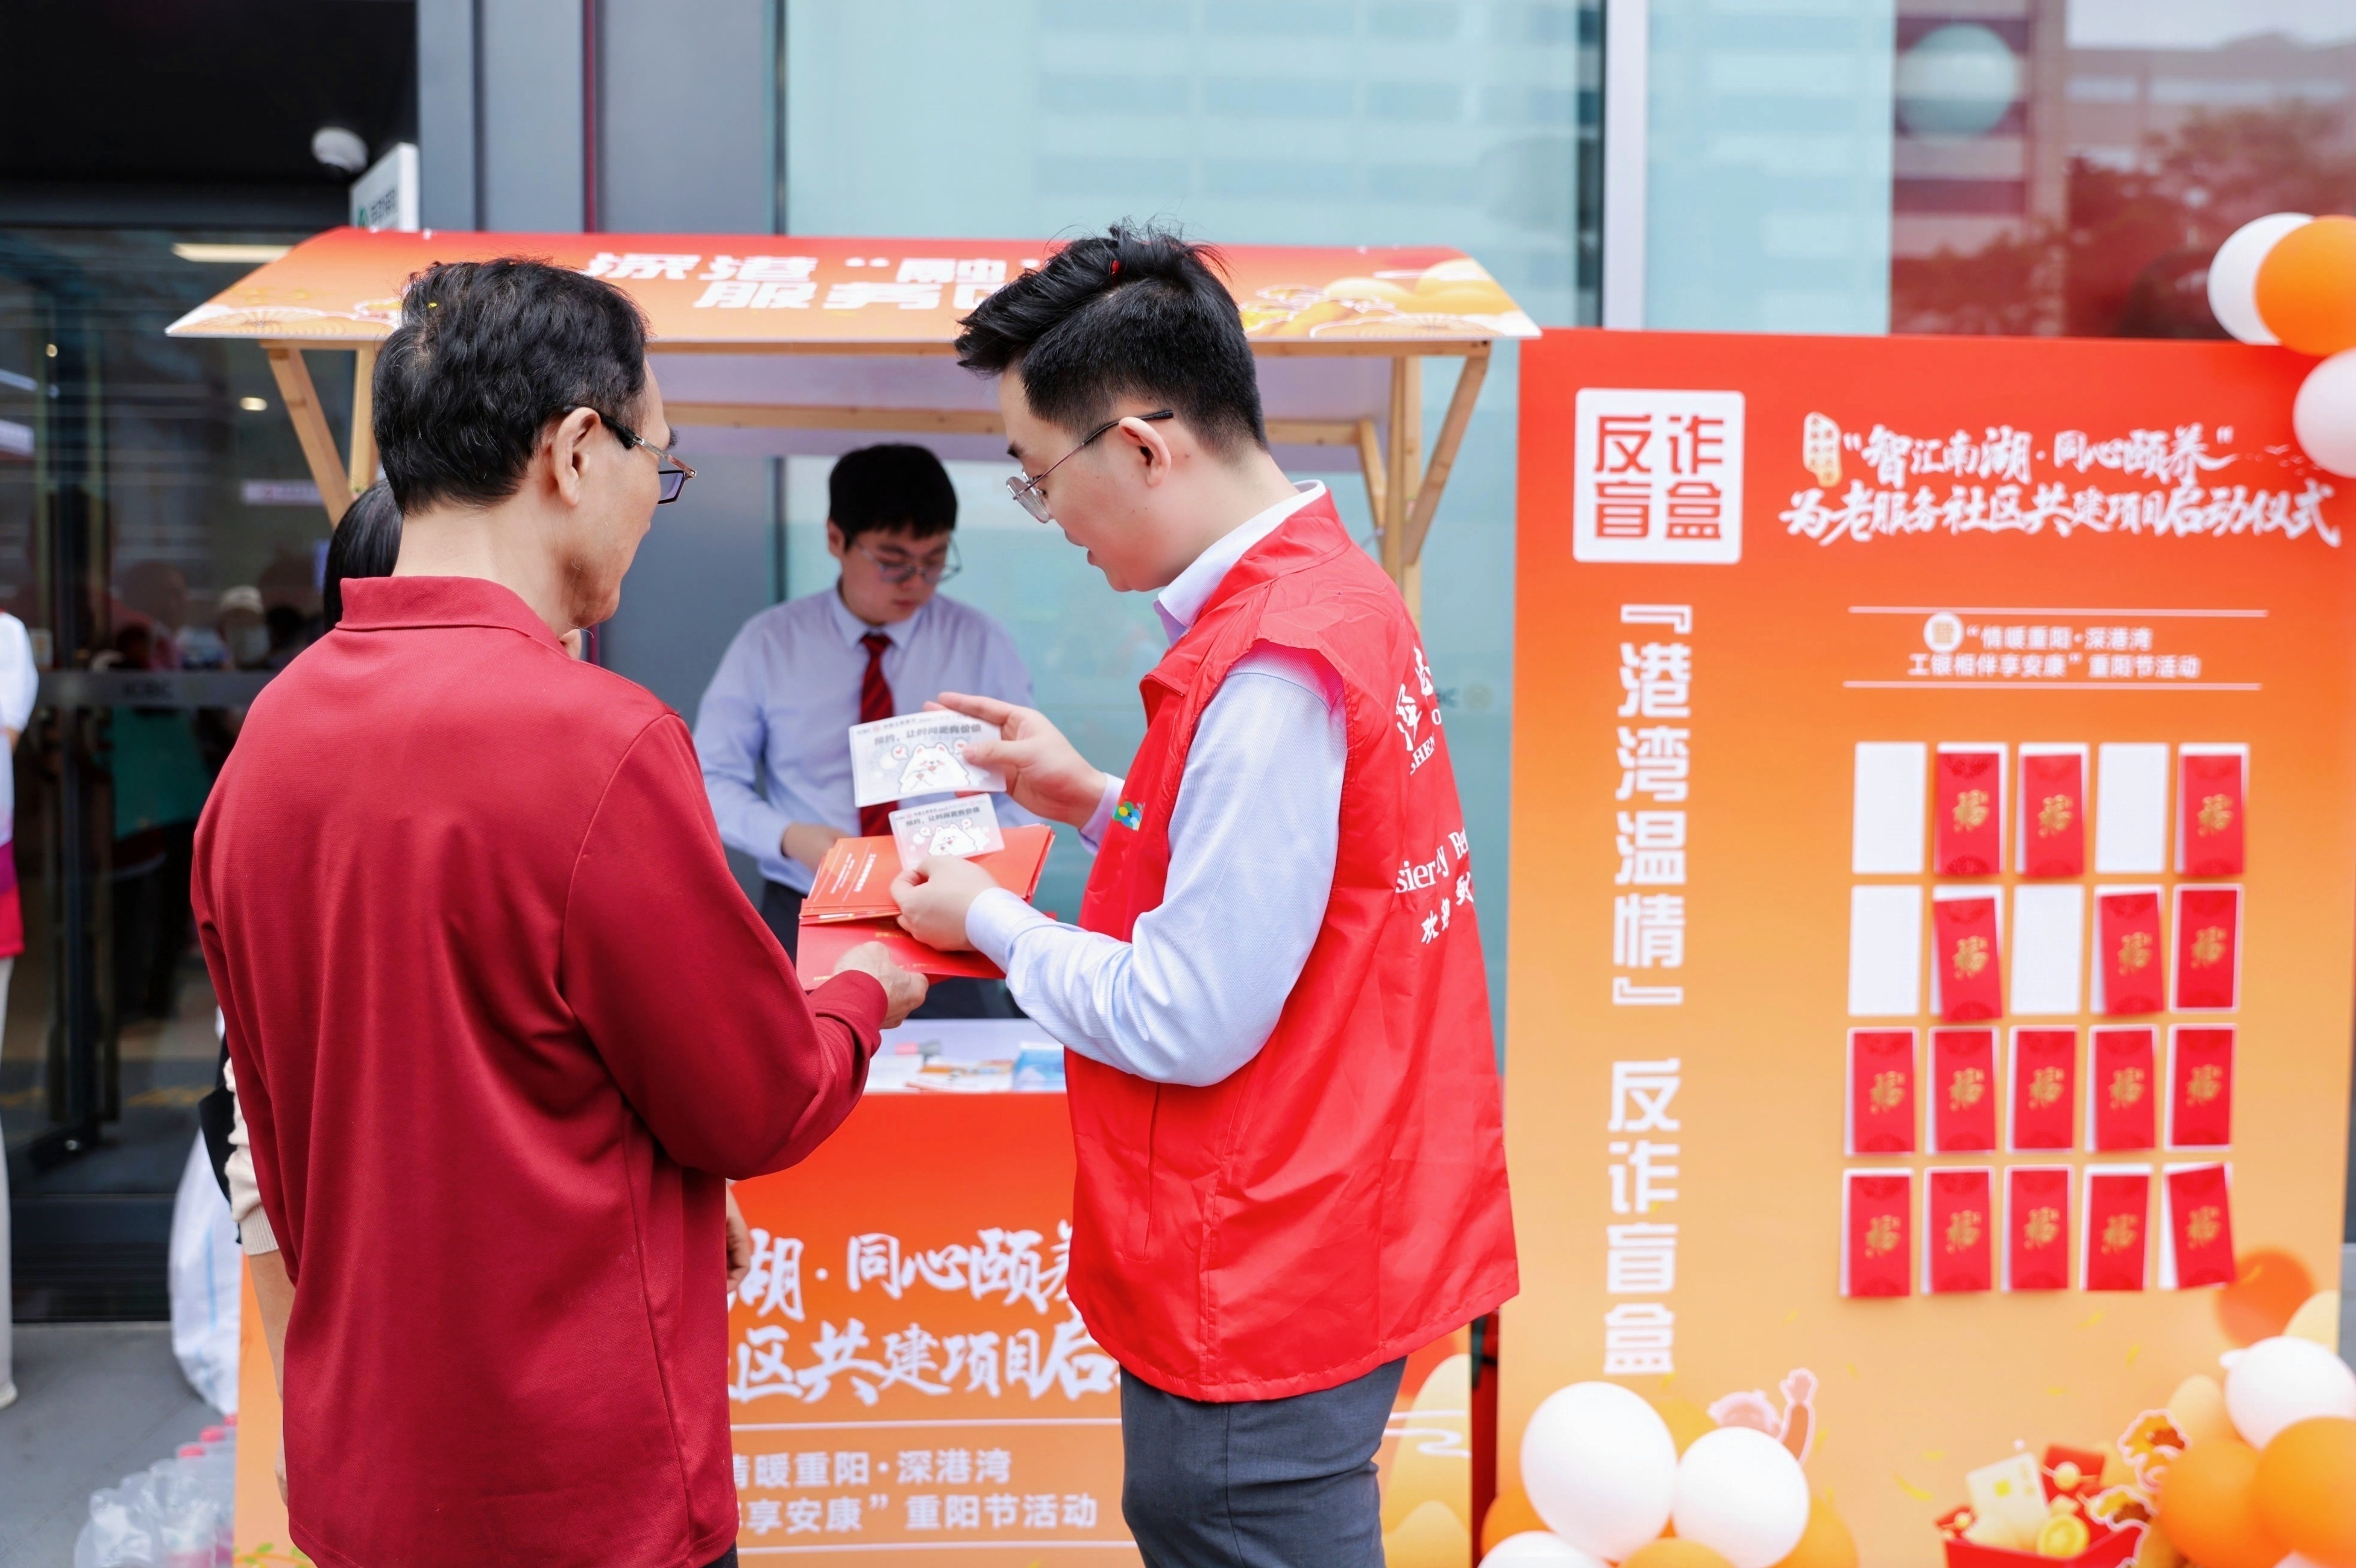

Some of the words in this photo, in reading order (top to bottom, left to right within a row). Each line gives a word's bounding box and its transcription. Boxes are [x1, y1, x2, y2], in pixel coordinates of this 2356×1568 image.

[1594, 413, 1724, 474] 反诈
[1594, 481, 1722, 539] 盲盒
[1778, 478, 2342, 548] 为老服务社区共建项目启动仪式
[1603, 1058, 1681, 1375] 反诈盲盒
[738, 1493, 1098, 1535] 享安康”重阳节活动
